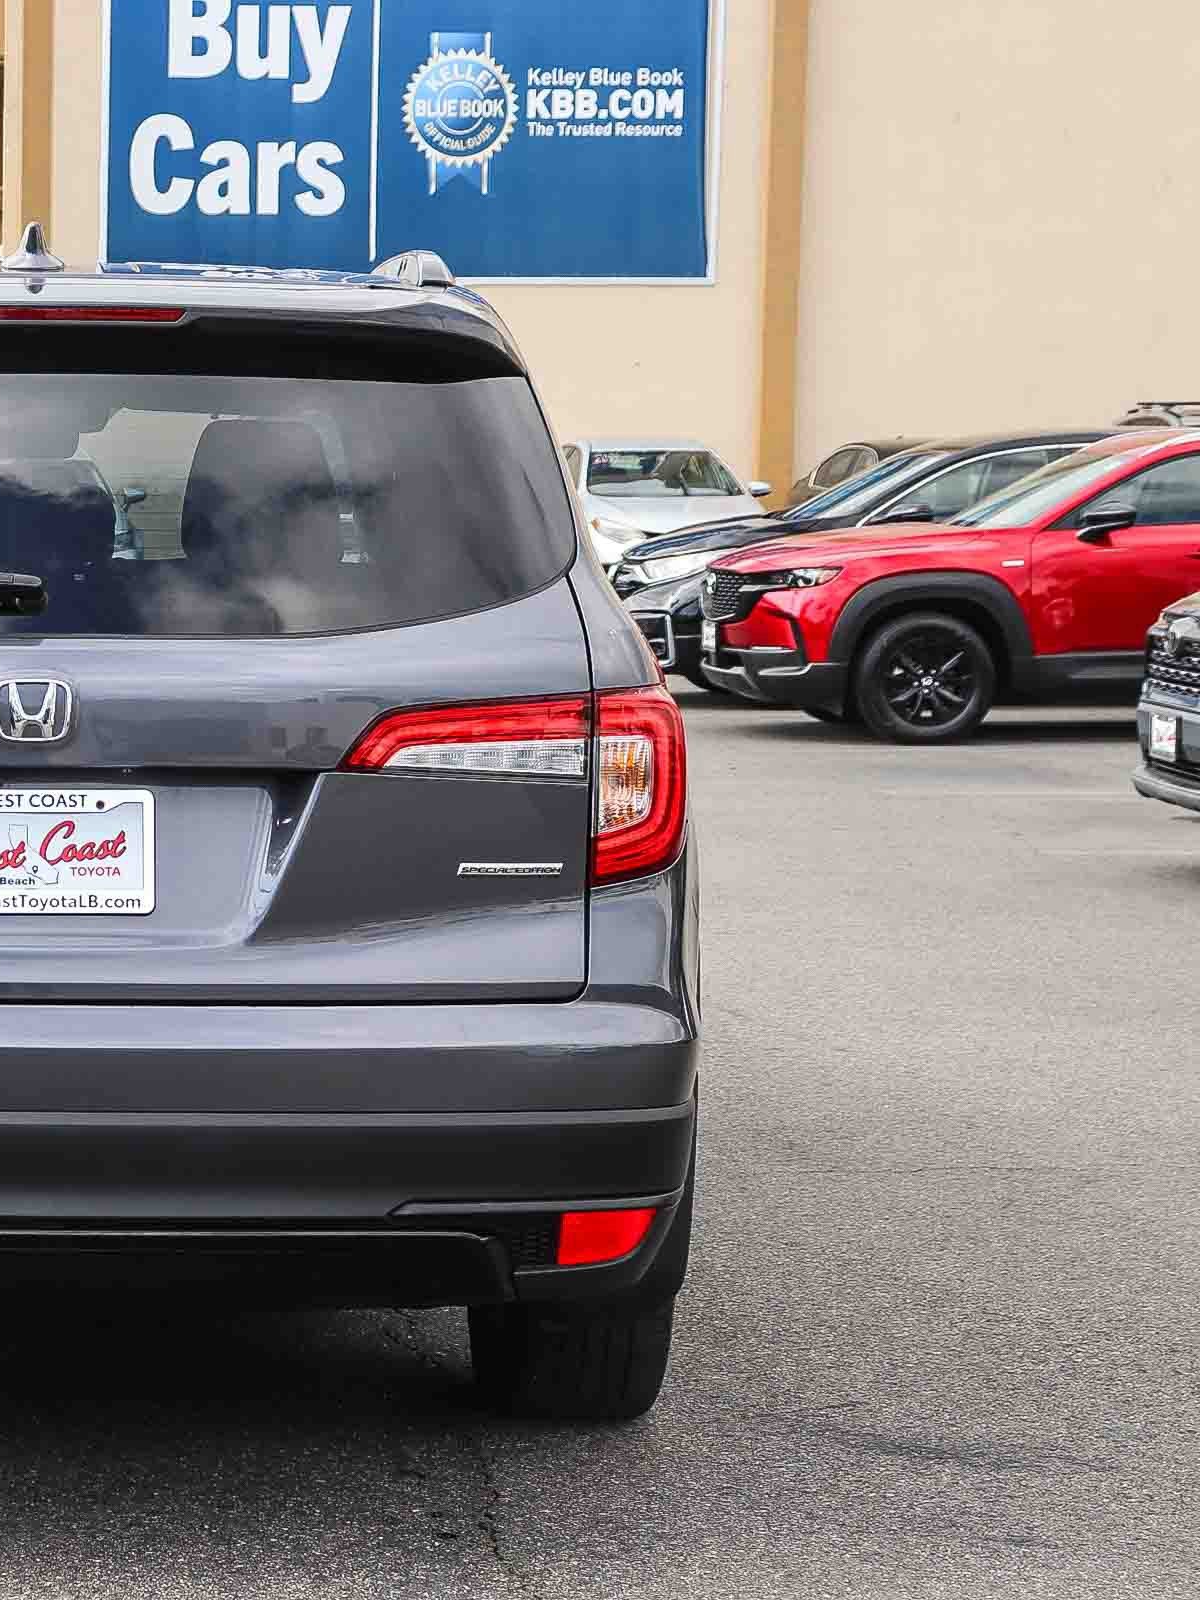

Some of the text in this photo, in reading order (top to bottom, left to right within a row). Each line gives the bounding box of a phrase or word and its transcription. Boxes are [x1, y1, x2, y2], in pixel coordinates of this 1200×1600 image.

[167, 0, 352, 103] Buy
[421, 62, 501, 94] KELLEY
[528, 67, 684, 89] Kelley Blue Book
[415, 99, 505, 118] BLUE BOOK
[526, 88, 685, 119] KBB.COM
[527, 121, 683, 137] The Trusted Resource
[129, 113, 346, 216] Cars
[29, 794, 88, 808] COAST
[39, 820, 127, 866] Coast
[0, 877, 36, 886] Beach
[70, 866, 121, 877] TOYOTA
